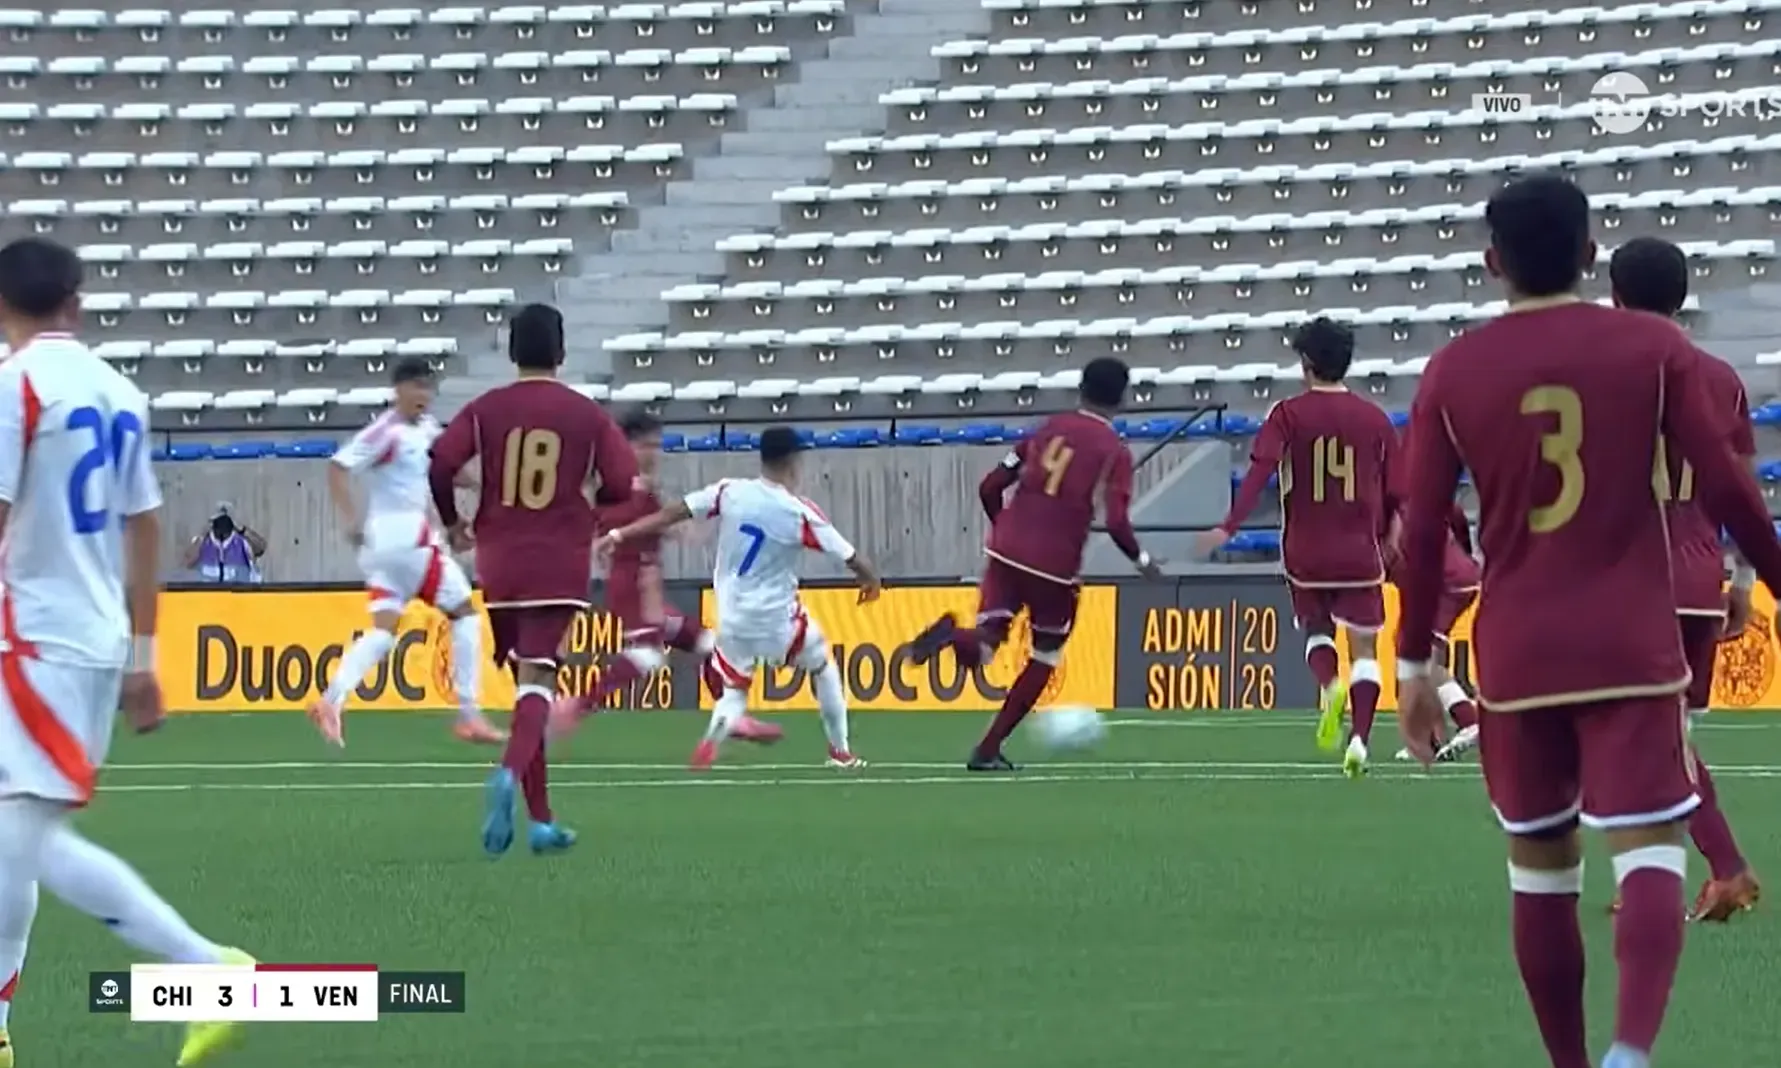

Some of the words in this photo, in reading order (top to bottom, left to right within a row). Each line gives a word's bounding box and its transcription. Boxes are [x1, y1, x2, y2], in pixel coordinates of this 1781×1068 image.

[500, 427, 563, 510] 18
[1041, 435, 1073, 496] 4
[1312, 435, 1355, 503] 14
[1520, 385, 1586, 533] 3
[738, 524, 765, 577] 7
[569, 610, 624, 655] DMI
[1143, 607, 1222, 653] ADMI
[1243, 607, 1277, 653] 20
[1147, 653, 1220, 710] SIÓN
[1241, 663, 1275, 710] 26
